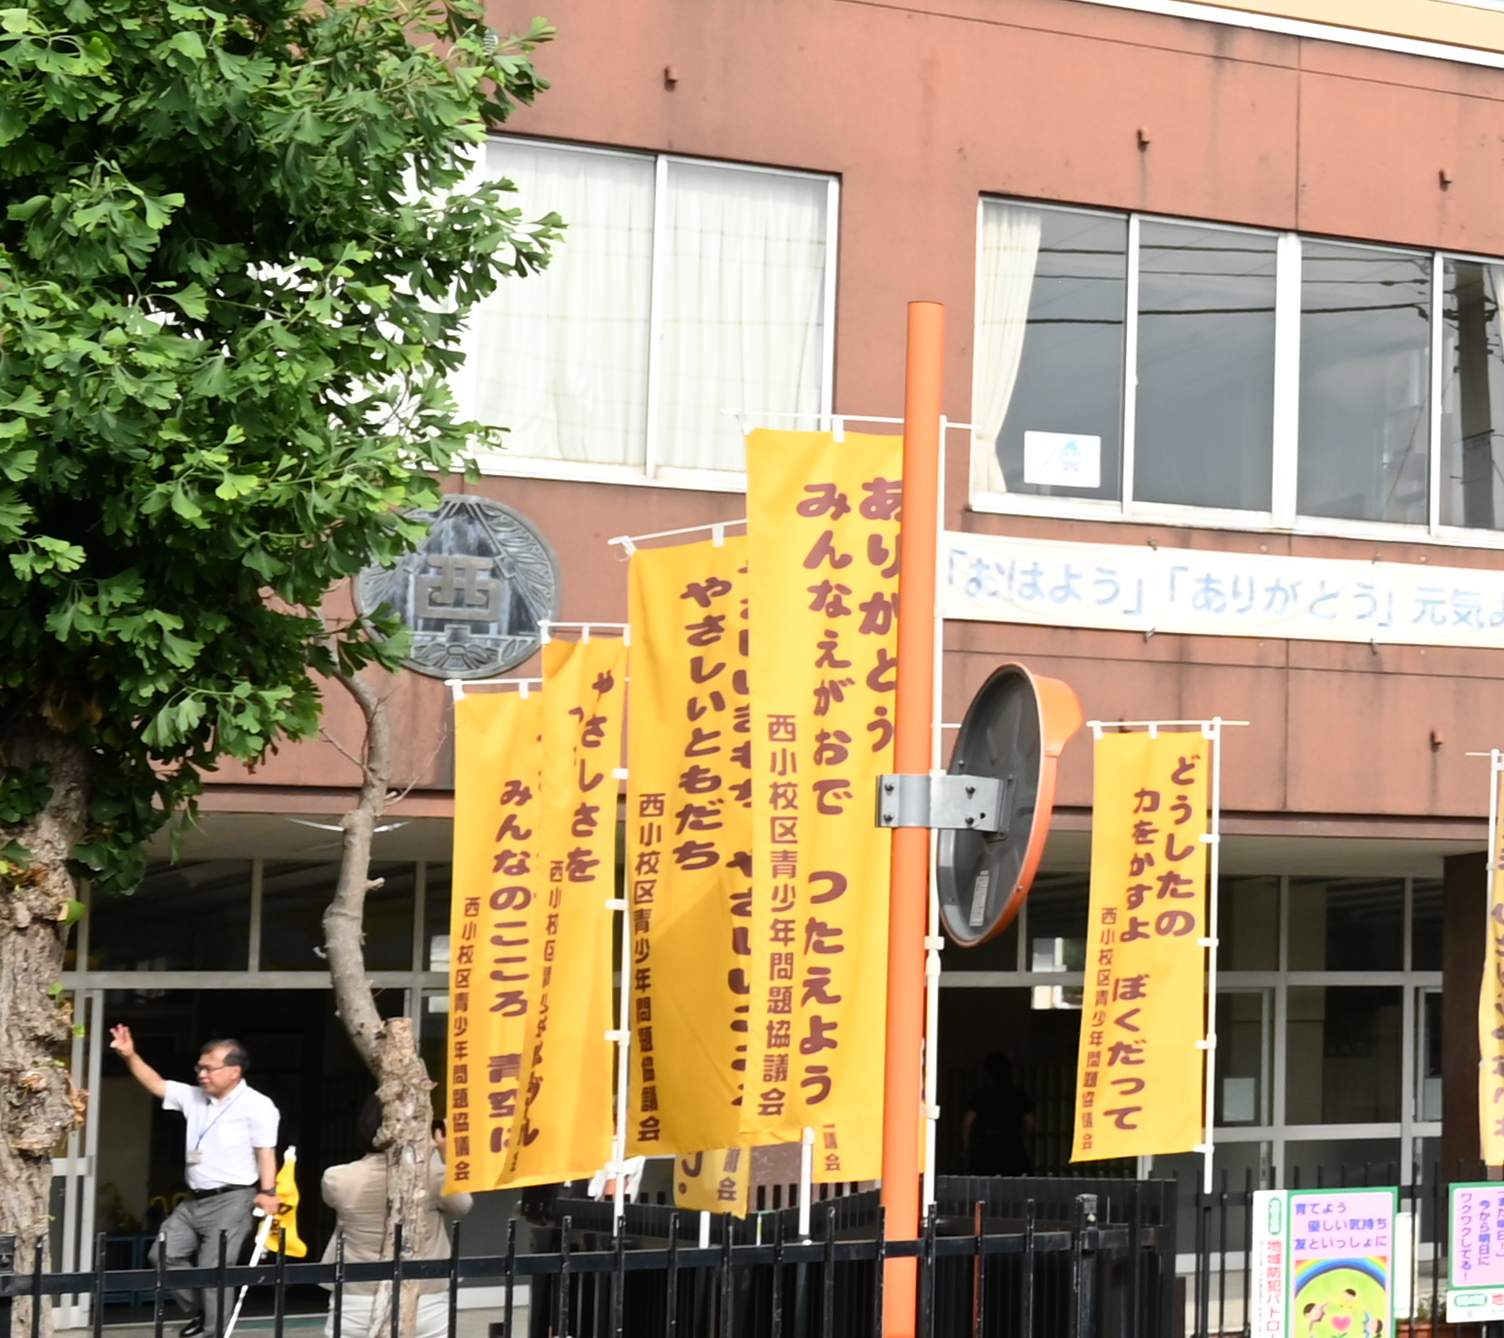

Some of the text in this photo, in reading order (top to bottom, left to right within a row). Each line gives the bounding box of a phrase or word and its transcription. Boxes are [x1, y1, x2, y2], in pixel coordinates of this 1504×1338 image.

[672, 576, 732, 871] やさしいともだち
[858, 476, 902, 752] ありがとう
[488, 780, 532, 1017] みんなのこころ
[796, 483, 855, 1105] みんなえがおで つたえよう
[1154, 754, 1201, 937] どうしたの
[757, 714, 798, 1116] 西小校区青少年問題協議会
[1081, 907, 1118, 1150] 西小校区青少年問題協議会
[452, 897, 480, 1181] 西小校区青少年問題協議会
[1103, 973, 1150, 1131] ぼくだって
[1294, 1235, 1387, 1250] 友といっしょに
[1295, 1202, 1347, 1215] 育てよう
[1308, 1218, 1387, 1232] 優しい気持ち
[1478, 1199, 1491, 1266] 今から明日に
